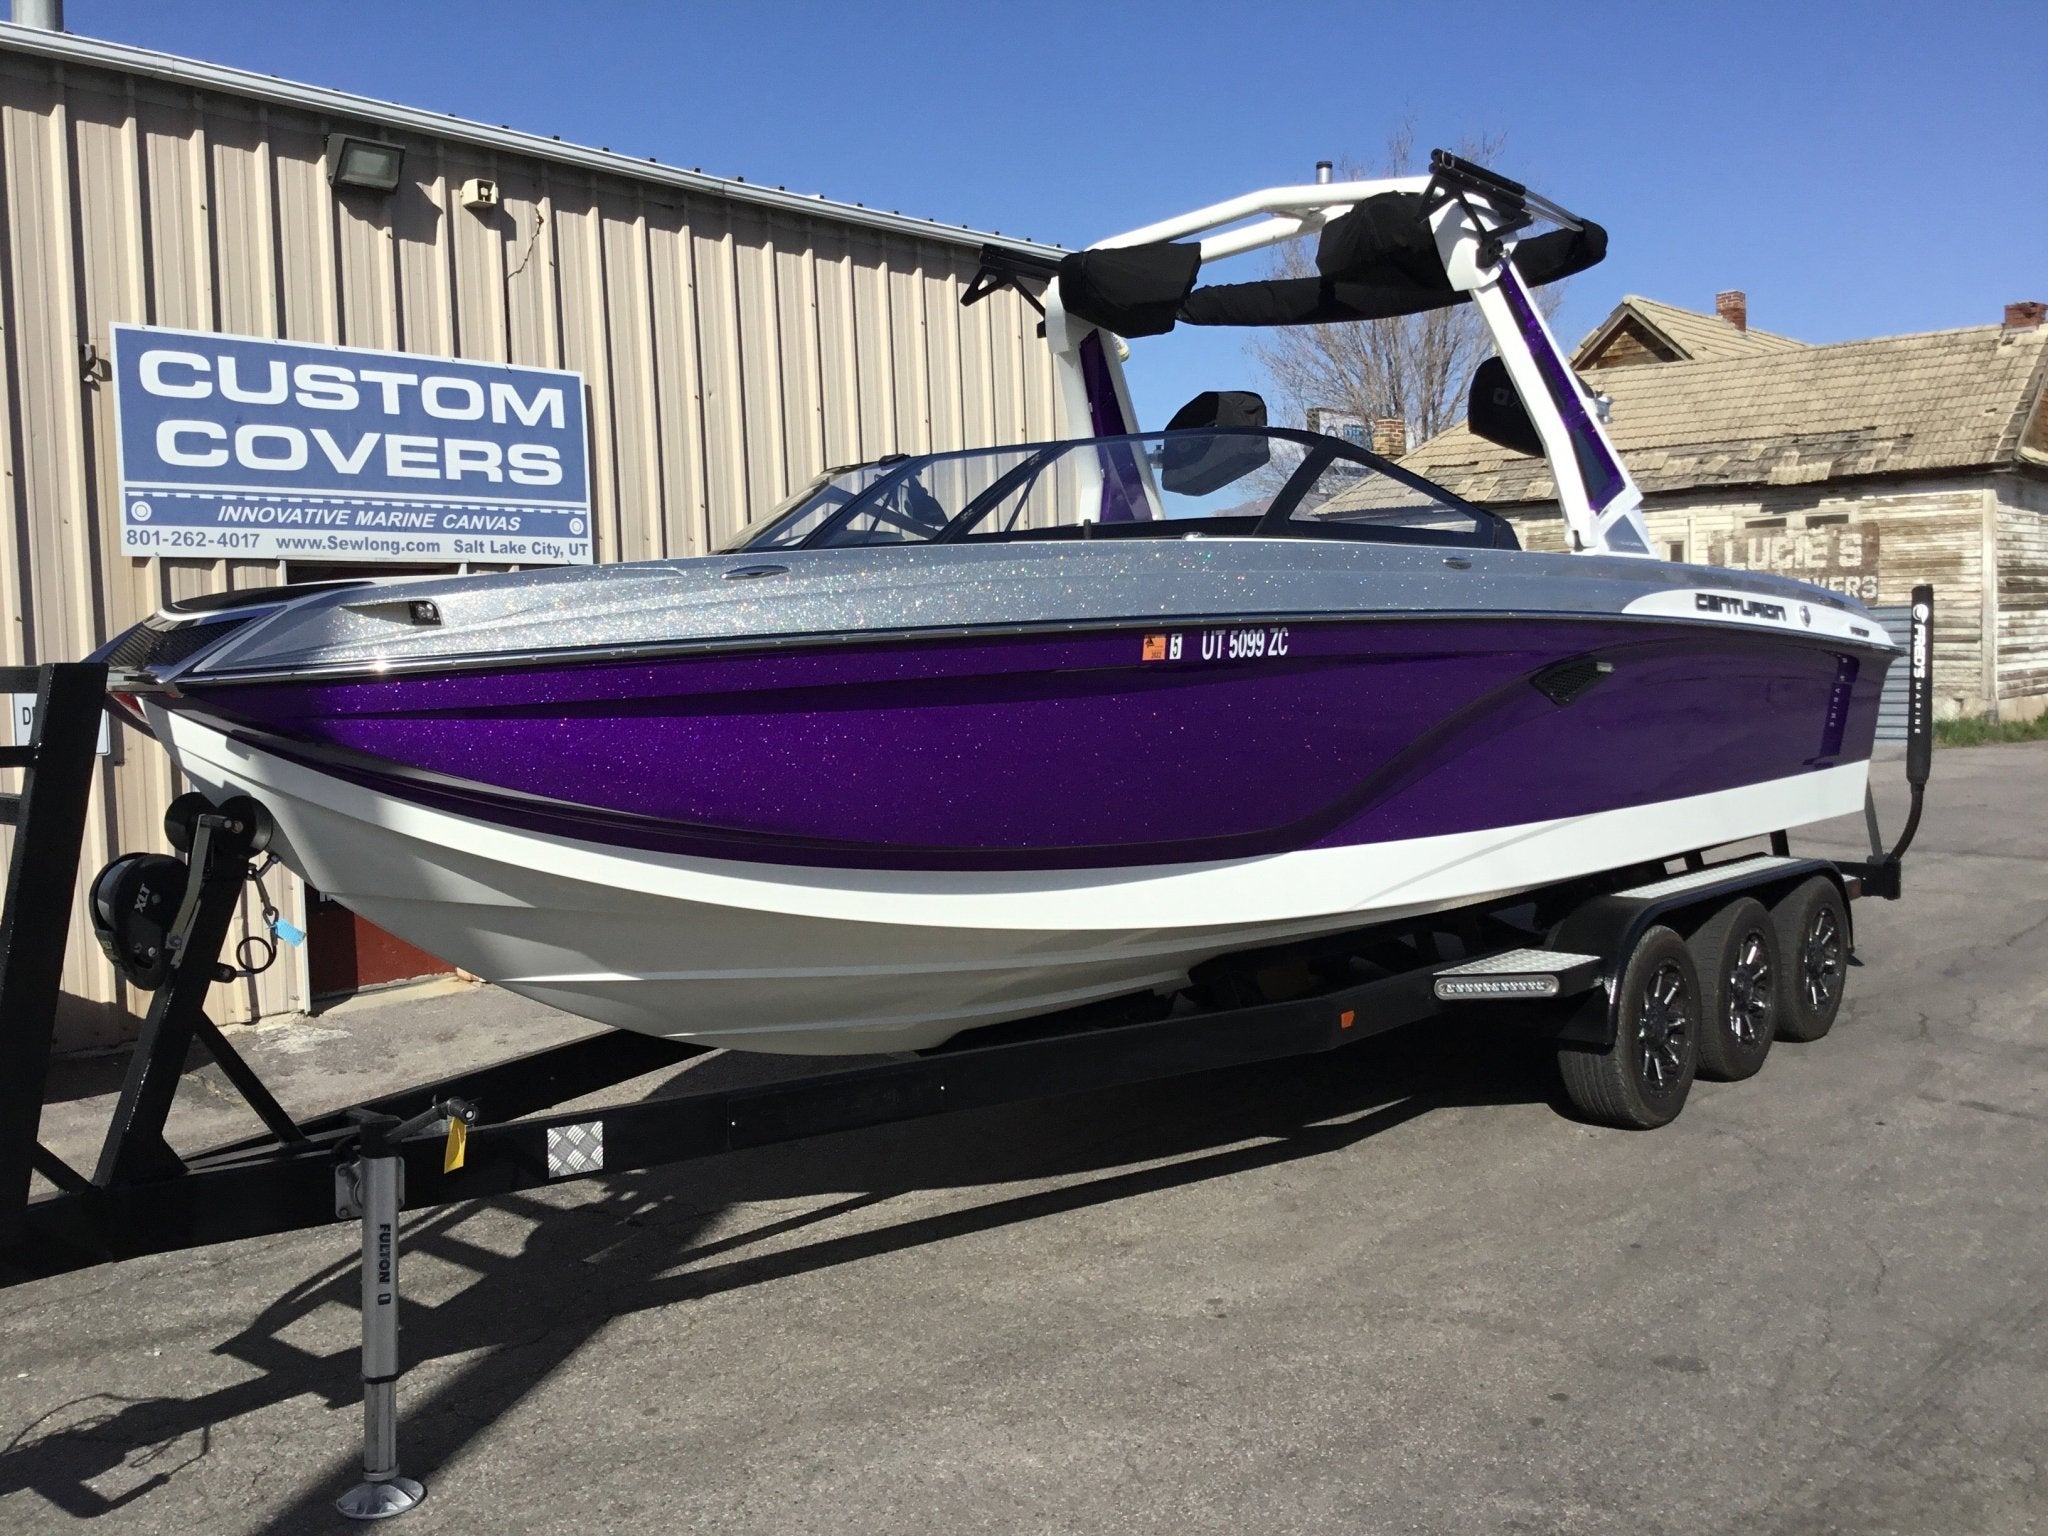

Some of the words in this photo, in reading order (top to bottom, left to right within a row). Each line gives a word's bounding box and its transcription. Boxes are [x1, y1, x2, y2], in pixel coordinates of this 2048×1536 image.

[139, 350, 565, 429] CUSTOM
[156, 419, 564, 486] COVERS
[126, 529, 260, 549] 801-262-4017
[276, 535, 440, 555] www.Sewlong.com
[454, 539, 485, 554] Salt
[490, 540, 527, 555] Lake
[531, 541, 564, 559] City,
[569, 543, 589, 556] UT
[217, 505, 351, 526] INNOVATIVE
[355, 511, 436, 528] MARINE
[443, 514, 521, 531] CANVAS
[1202, 630, 1226, 660] UT
[1229, 629, 1265, 659] 5099
[1267, 627, 1289, 657] ZC
[1914, 682, 1922, 734] MARINE
[379, 1223, 391, 1283] FULTON
